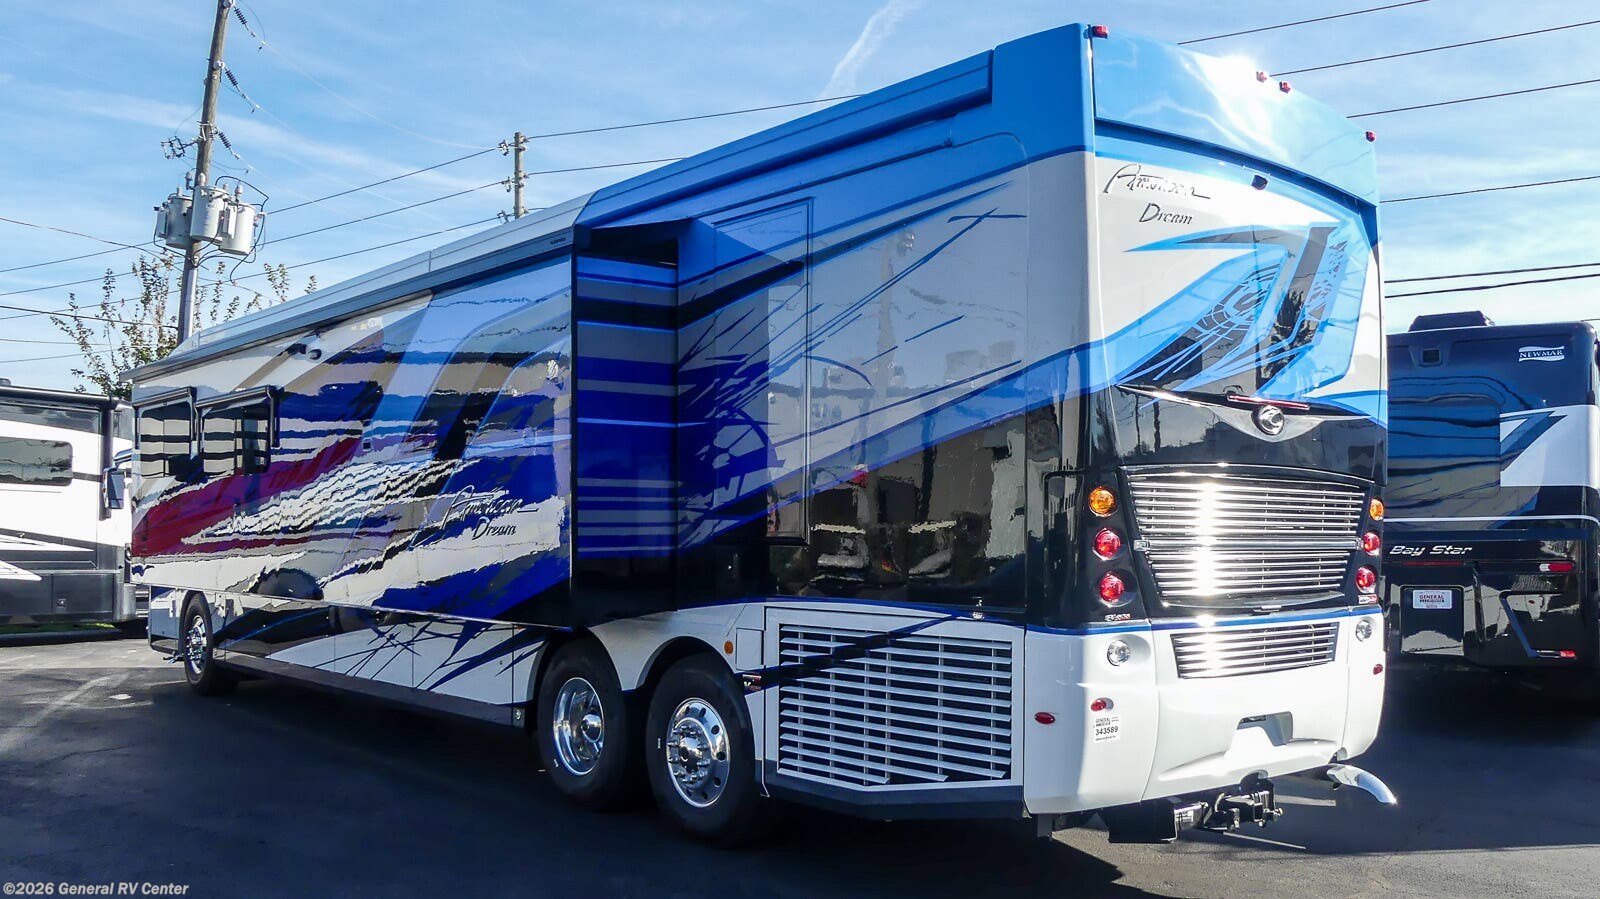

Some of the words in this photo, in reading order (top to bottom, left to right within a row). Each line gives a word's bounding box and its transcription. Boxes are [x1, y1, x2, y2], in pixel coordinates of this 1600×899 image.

[1139, 202, 1193, 225] Dream
[1519, 350, 1564, 358] NEWMAR
[472, 516, 517, 540] Dream
[1389, 545, 1426, 556] Bay
[1429, 545, 1473, 555] Star
[1095, 725, 1119, 736] 343589
